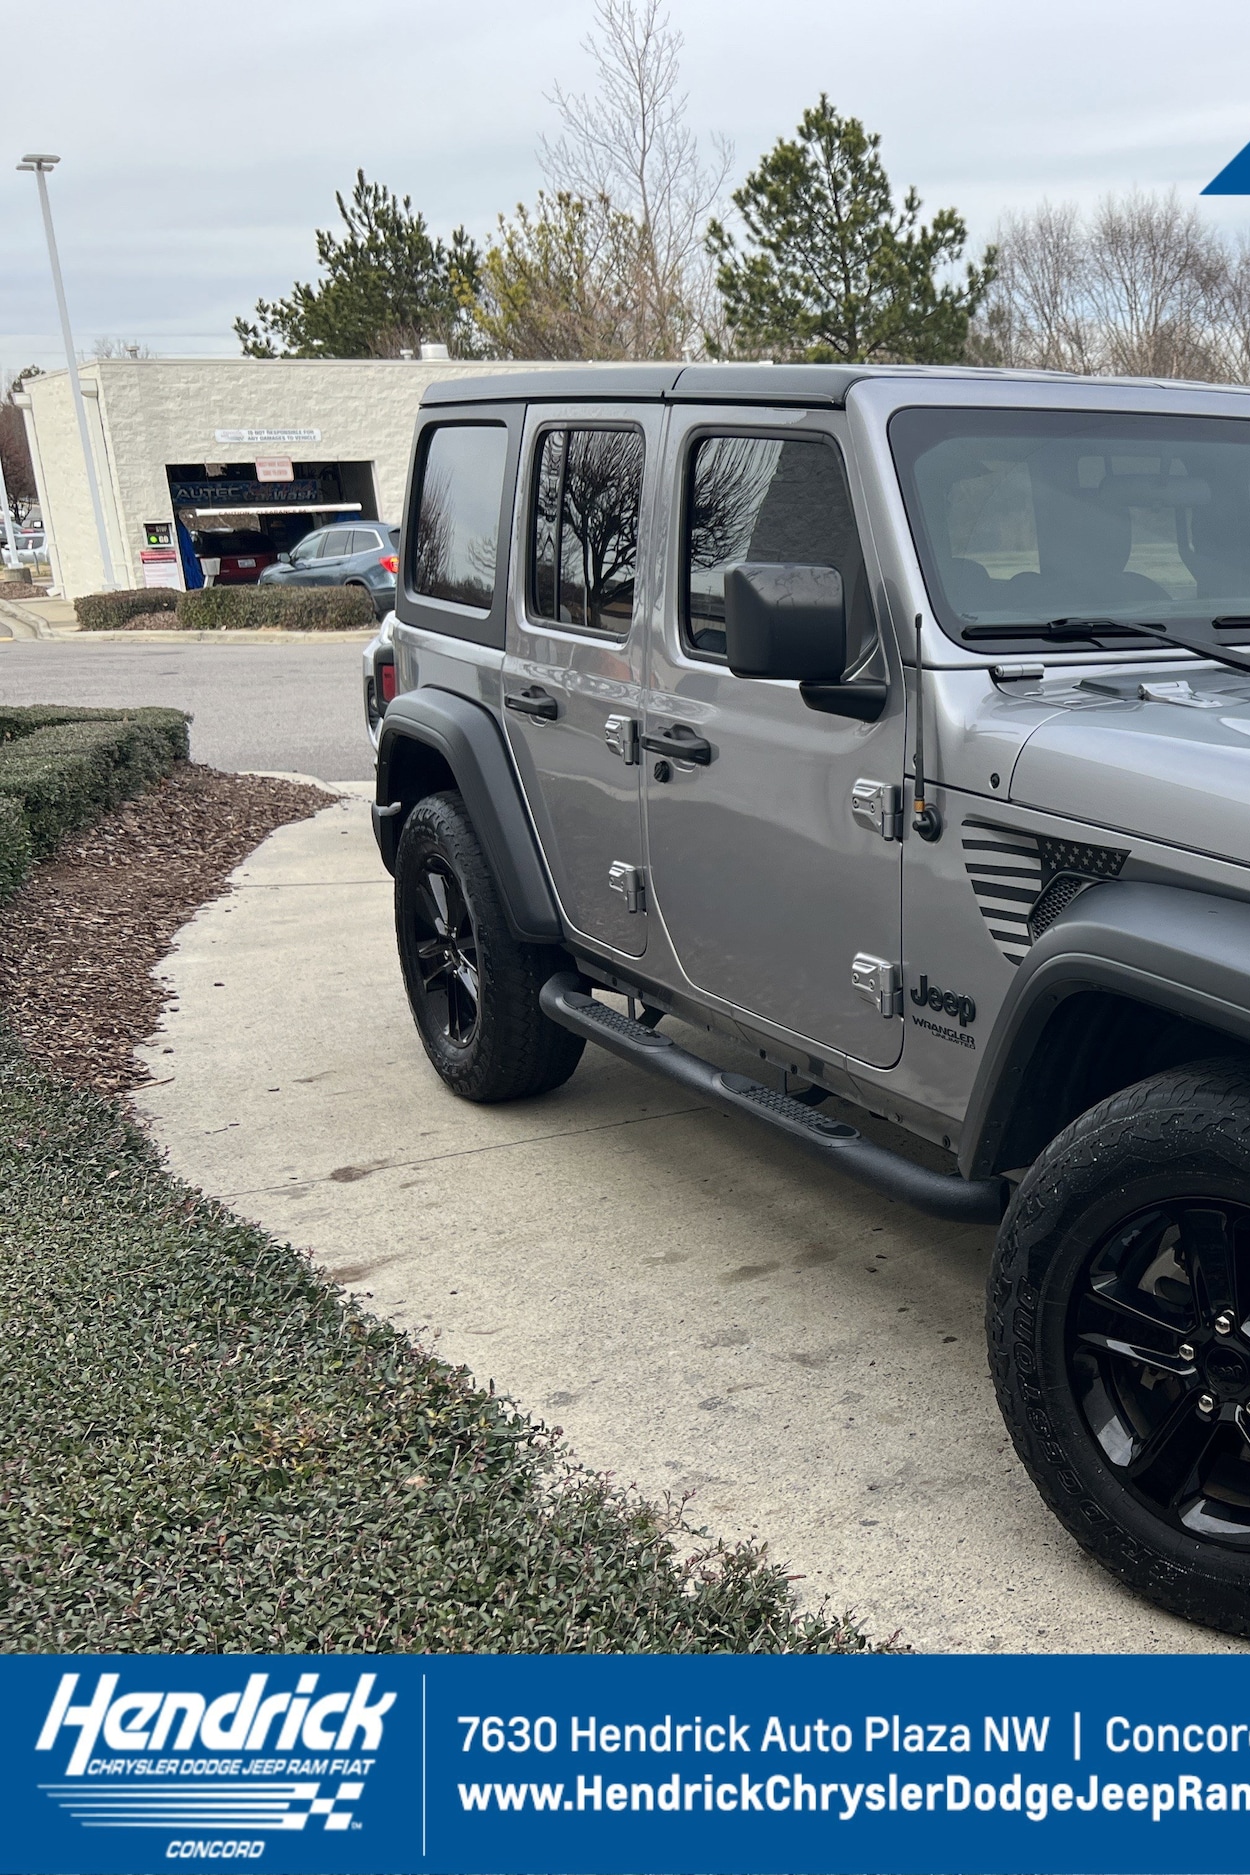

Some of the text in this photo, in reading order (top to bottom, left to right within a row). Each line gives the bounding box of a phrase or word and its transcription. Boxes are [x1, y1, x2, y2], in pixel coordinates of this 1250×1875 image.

[176, 487, 241, 499] AUTEC
[273, 489, 317, 500] Wash
[910, 973, 976, 1028] Jeep
[912, 1015, 975, 1045] WRANGLER
[931, 1030, 976, 1050] UNLIMITED
[1012, 1275, 1189, 1585] BRIDGESTONE
